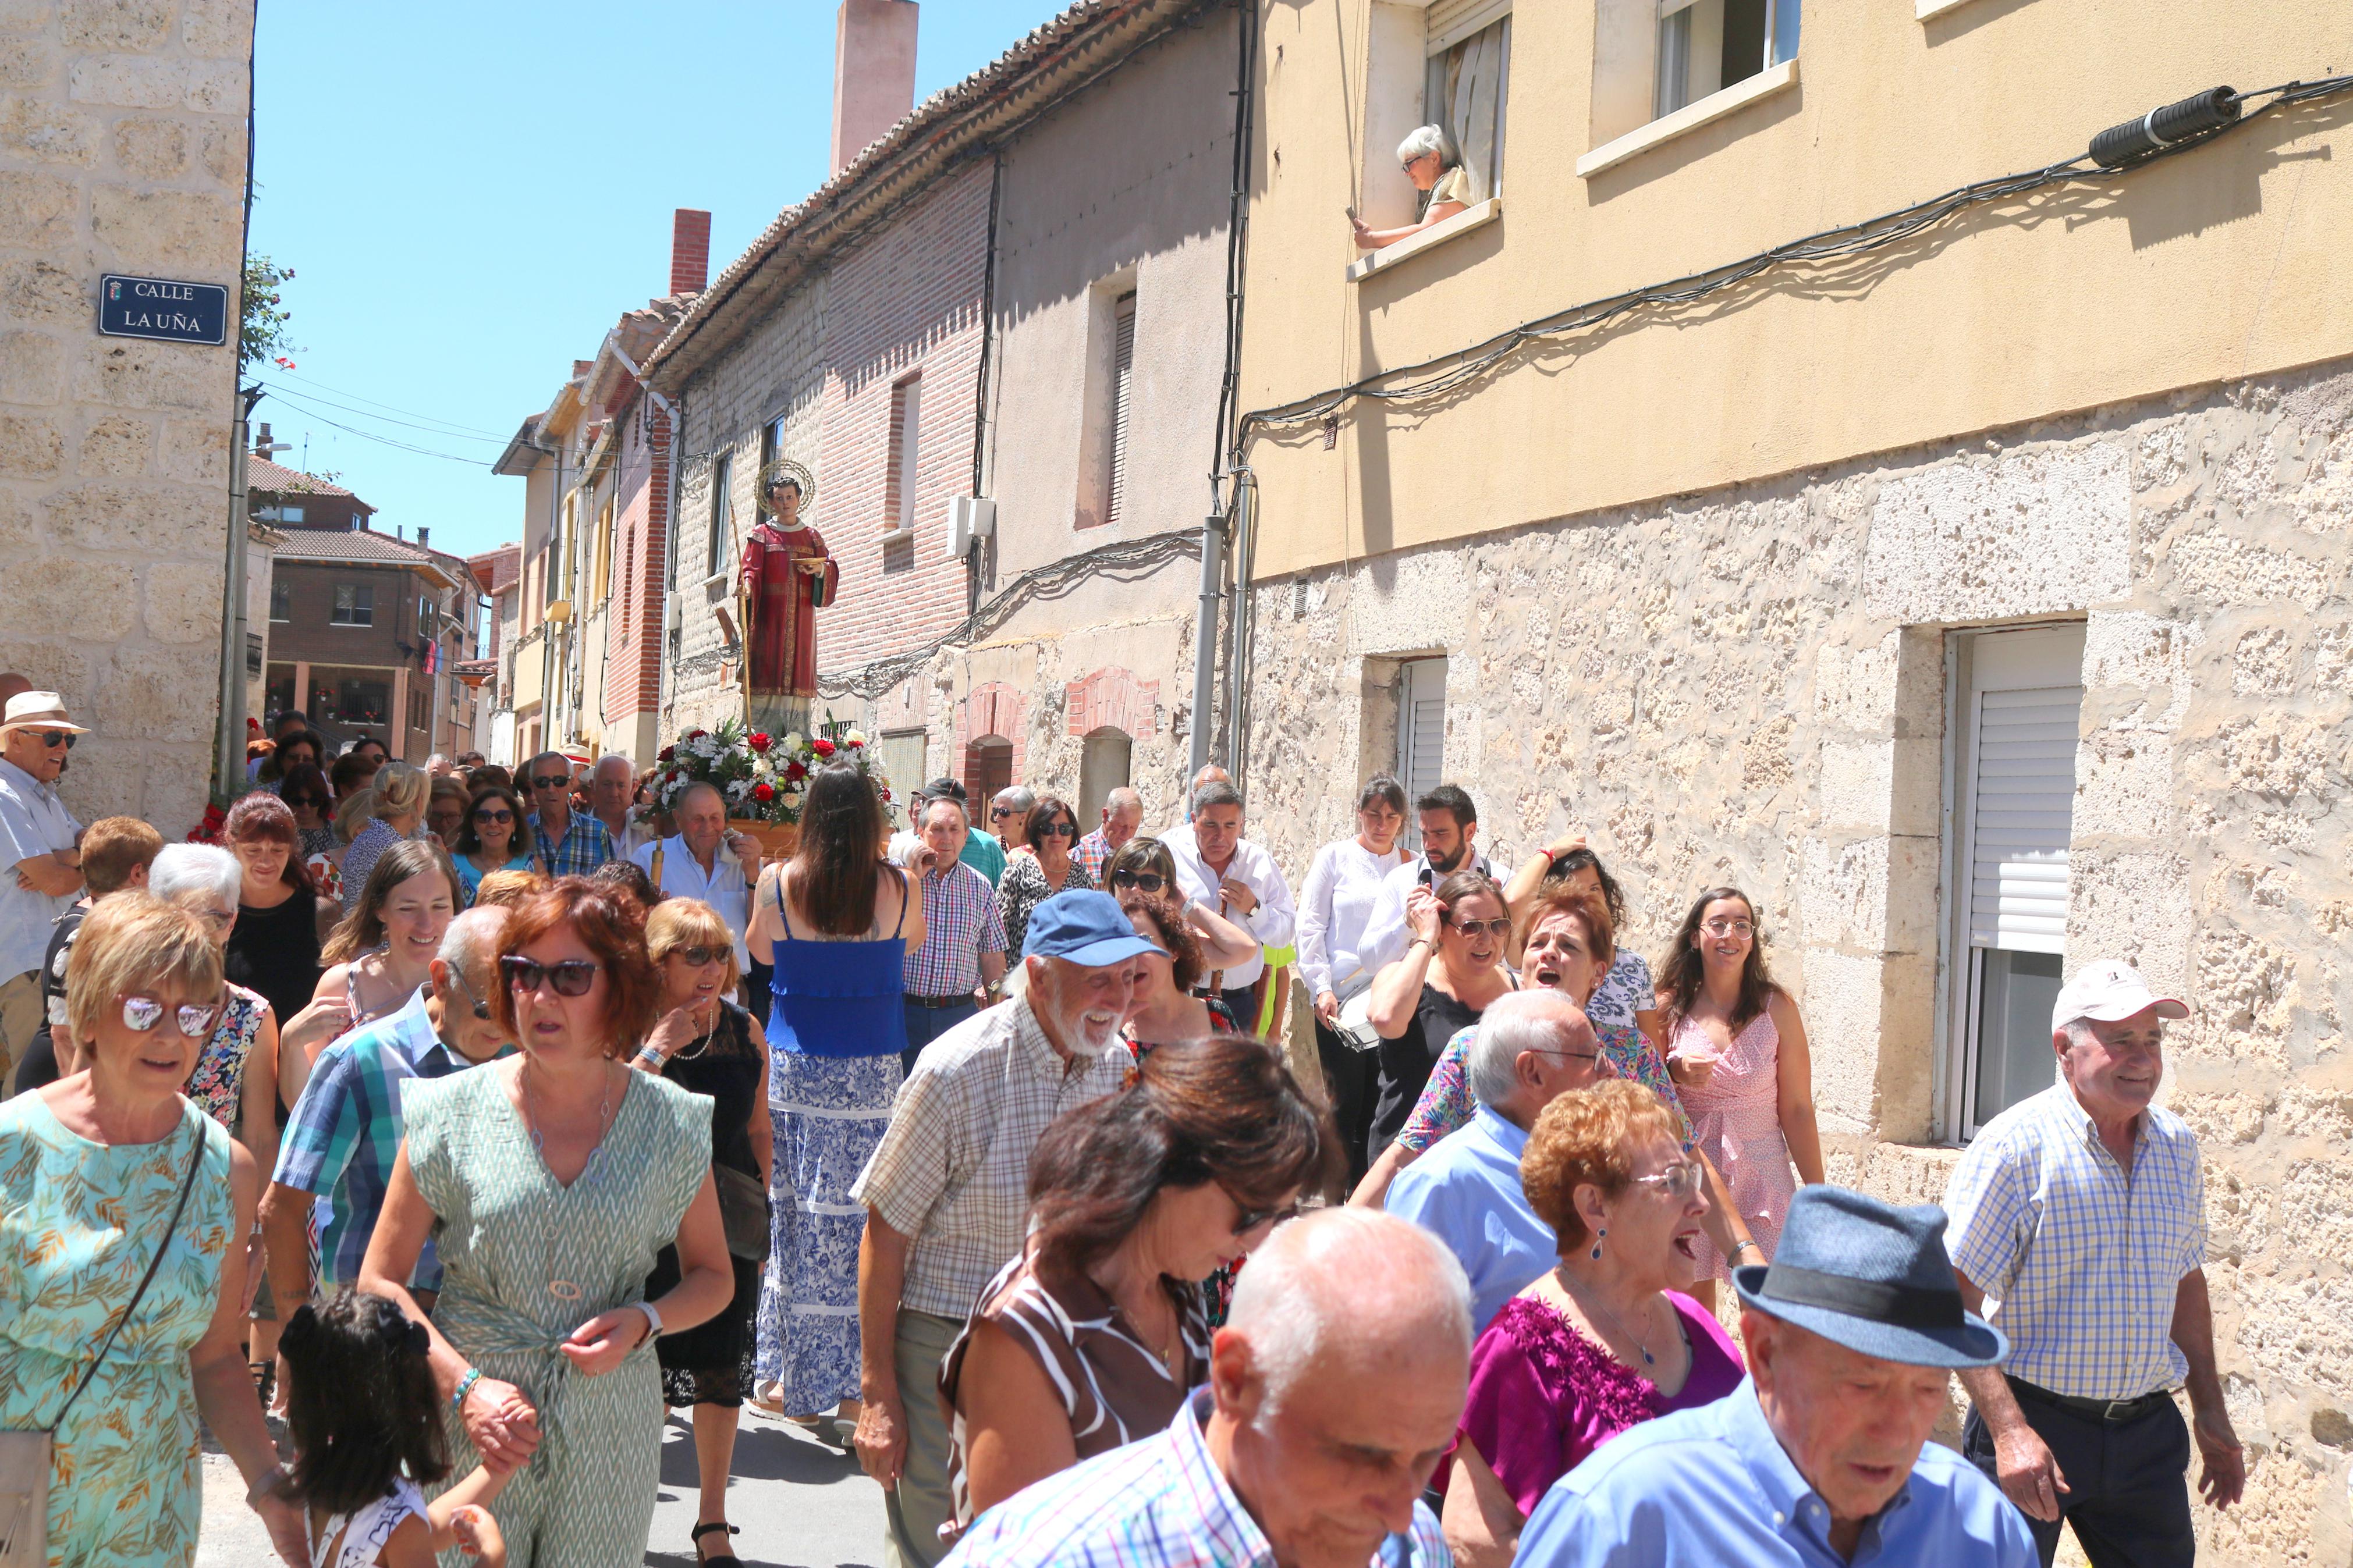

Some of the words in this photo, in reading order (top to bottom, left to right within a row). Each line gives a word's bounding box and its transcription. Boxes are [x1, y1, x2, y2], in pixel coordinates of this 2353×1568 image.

[135, 283, 194, 301] CALLE
[124, 311, 152, 328] LA
[156, 312, 202, 332] UÑA
